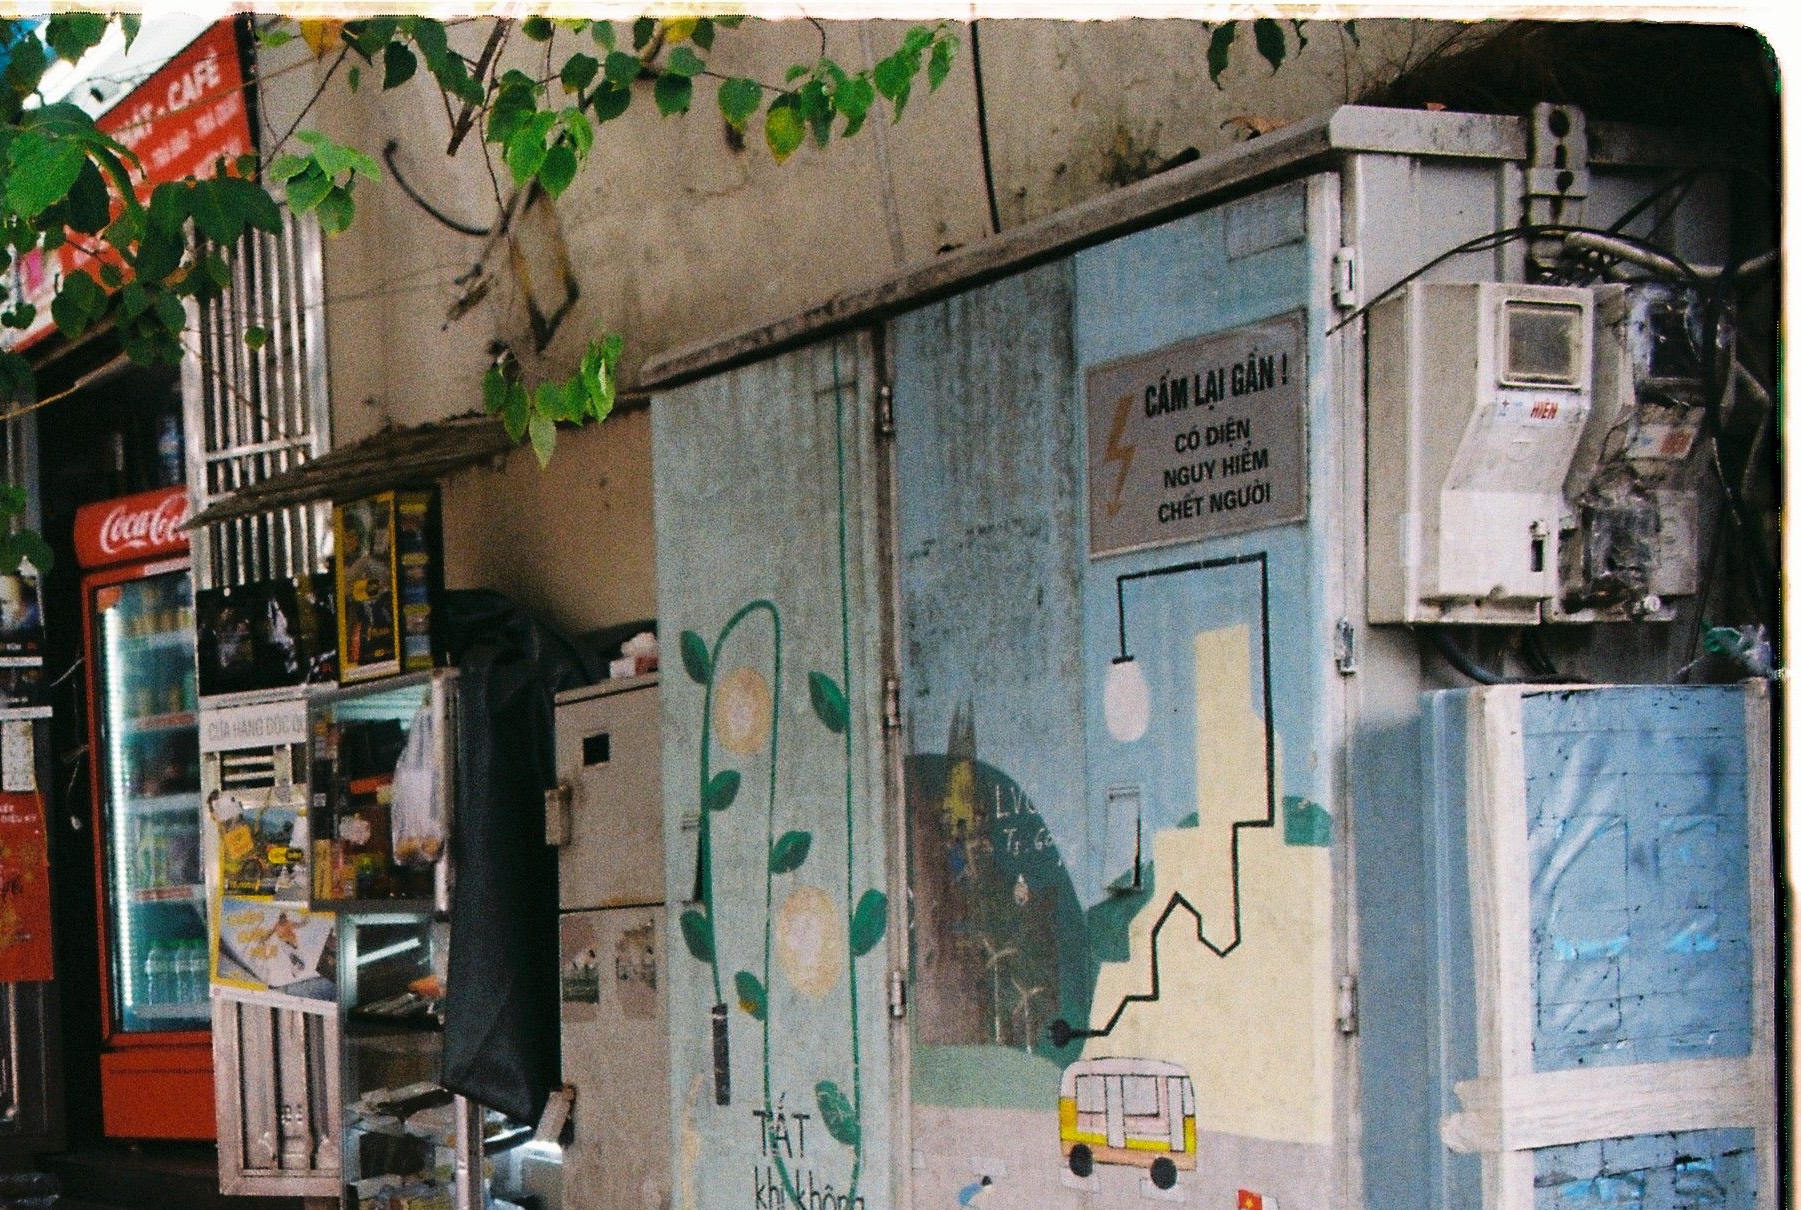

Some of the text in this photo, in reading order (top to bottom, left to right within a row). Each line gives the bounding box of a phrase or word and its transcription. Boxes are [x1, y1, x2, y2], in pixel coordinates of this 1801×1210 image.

[1145, 346, 1288, 417] CẤM LẠI GẦN !
[1175, 416, 1251, 453] CÓ ĐIỆN
[1164, 441, 1269, 489] NGUY HIỂM
[1158, 479, 1271, 523] CHẾT NGƯỜI
